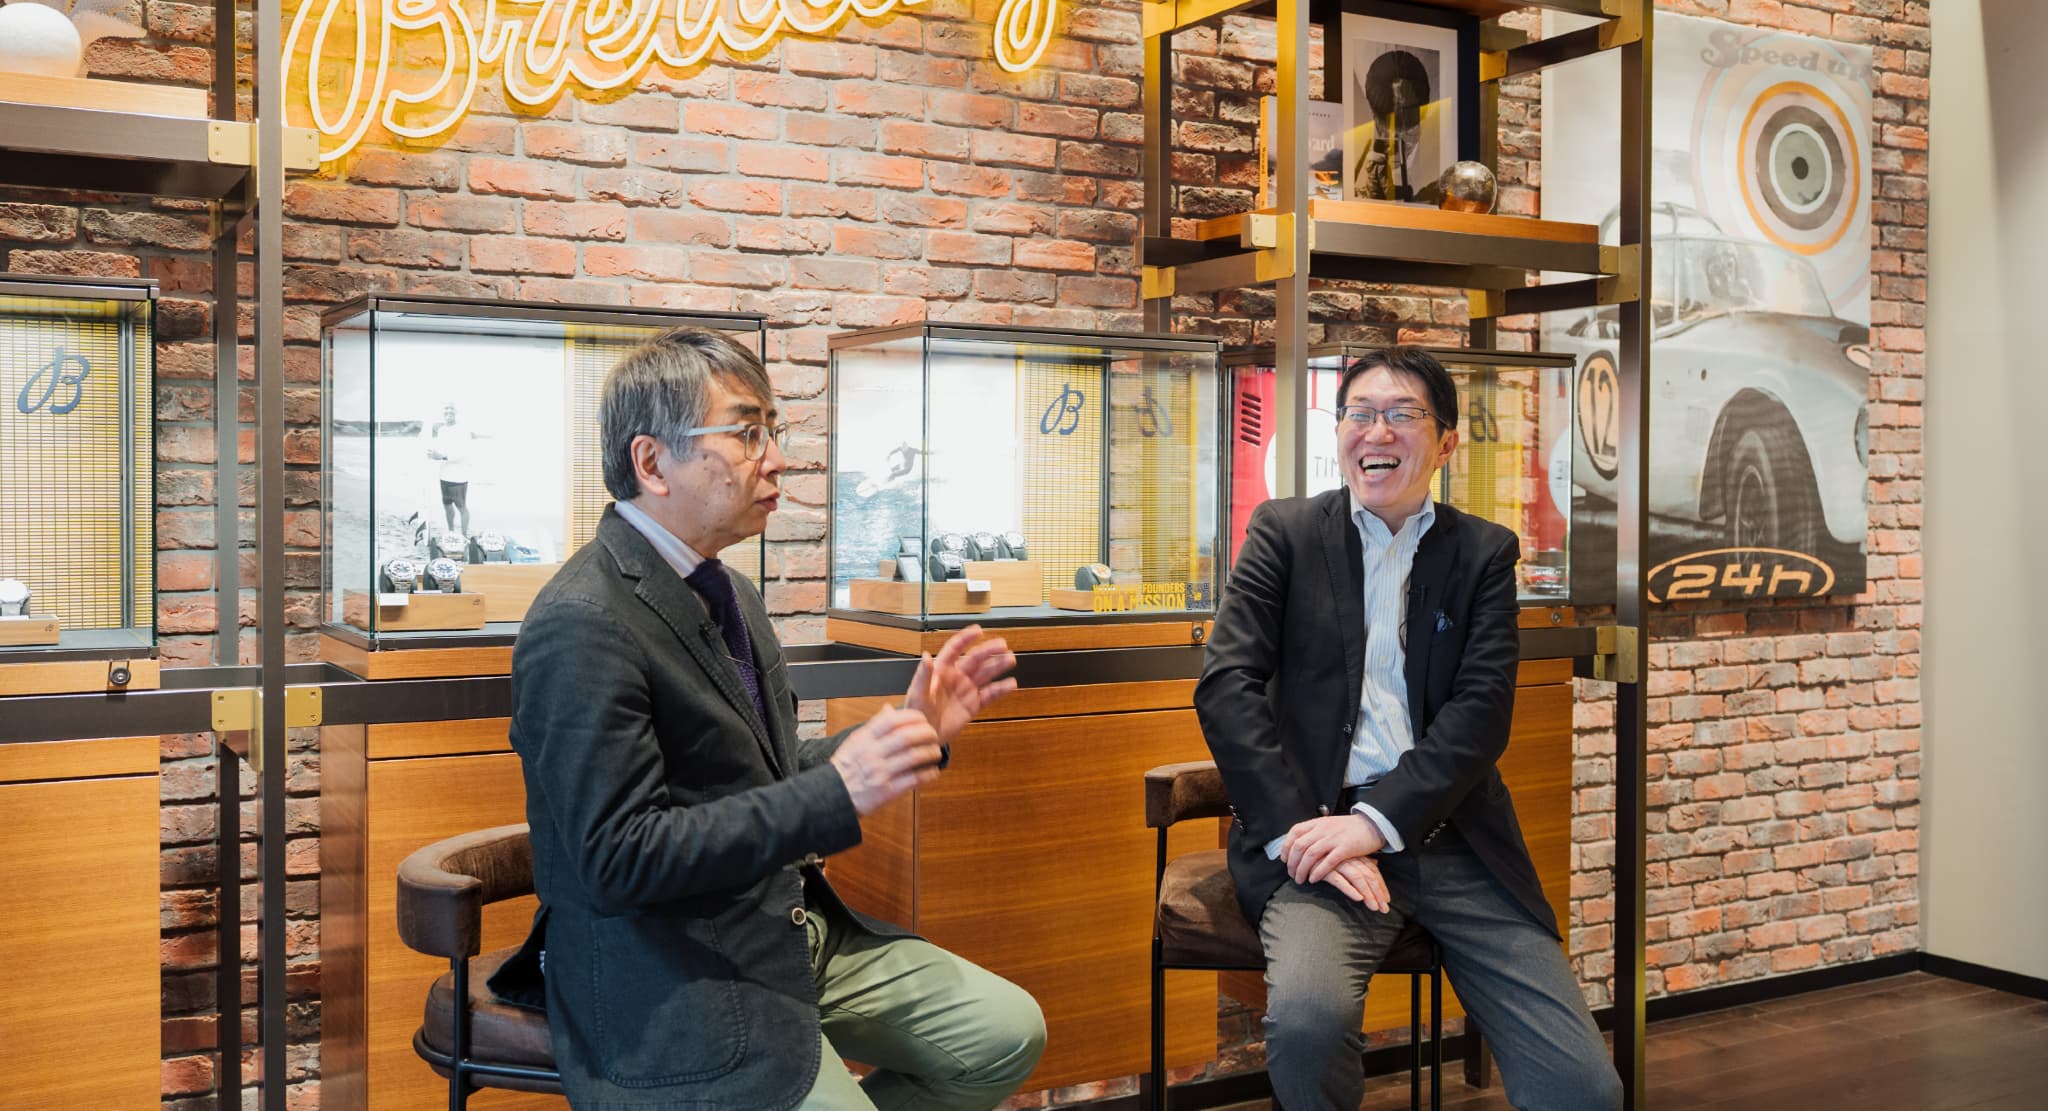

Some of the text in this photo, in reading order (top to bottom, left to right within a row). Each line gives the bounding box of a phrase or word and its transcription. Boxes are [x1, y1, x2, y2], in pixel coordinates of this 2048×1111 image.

[1702, 29, 1819, 71] Speed
[1587, 367, 1617, 458] 12
[1142, 582, 1185, 594] FOUNDERS
[1667, 563, 1813, 600] 24h
[1093, 594, 1186, 613] ON A MISSION
